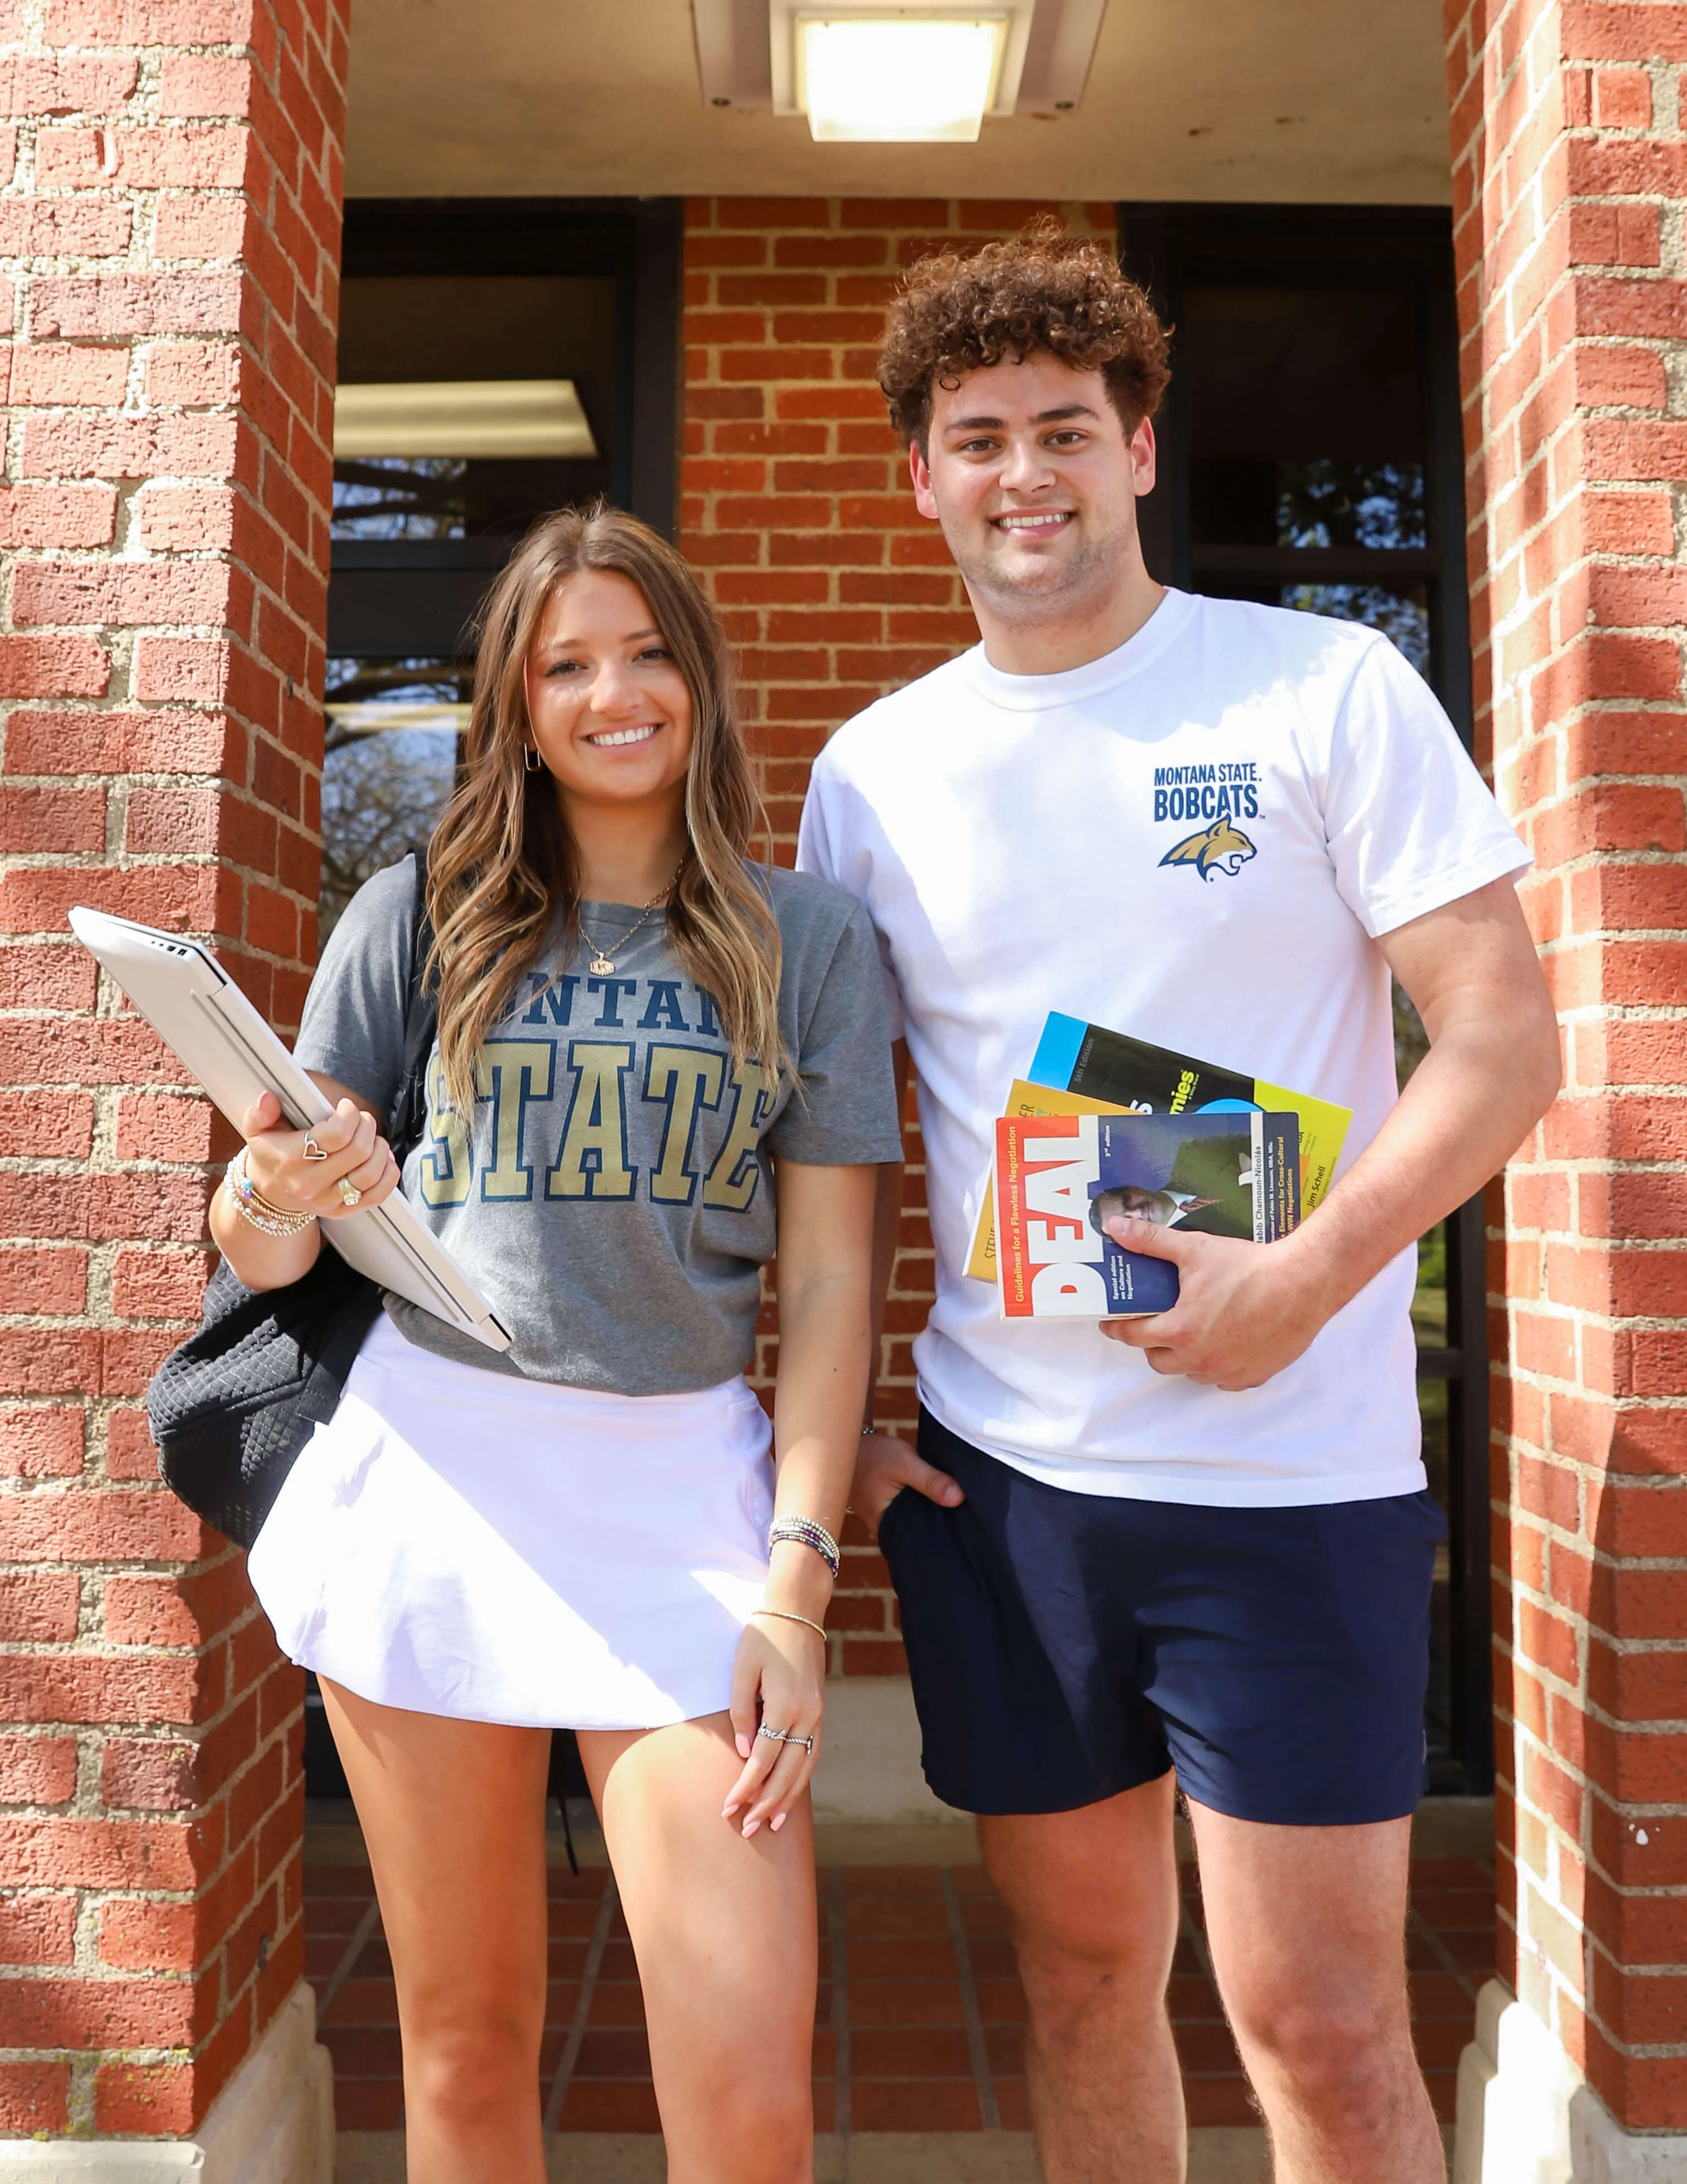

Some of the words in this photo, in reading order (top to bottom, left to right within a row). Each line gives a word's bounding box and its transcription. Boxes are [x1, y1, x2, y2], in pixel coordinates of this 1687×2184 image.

[1154, 764, 1216, 786] MONTANA
[1154, 784, 1259, 822] BOBCATS
[1074, 1068, 1084, 1083] 5th
[1079, 1038, 1095, 1067] Edition
[1169, 1070, 1195, 1115] mies
[420, 1038, 782, 1214] STATE
[1008, 1125, 1019, 1182] Negotiation
[1010, 1184, 1020, 1226] Flawless
[1286, 1168, 1295, 1214] Negotiations
[1307, 1192, 1317, 1209] Jim
[1312, 1165, 1326, 1192] Schell
[1024, 1115, 1109, 1317] DEAL
[1011, 1236, 1021, 1249] for
[1013, 1252, 1024, 1302] Guidelines
[1125, 1264, 1134, 1300] Negotiation
